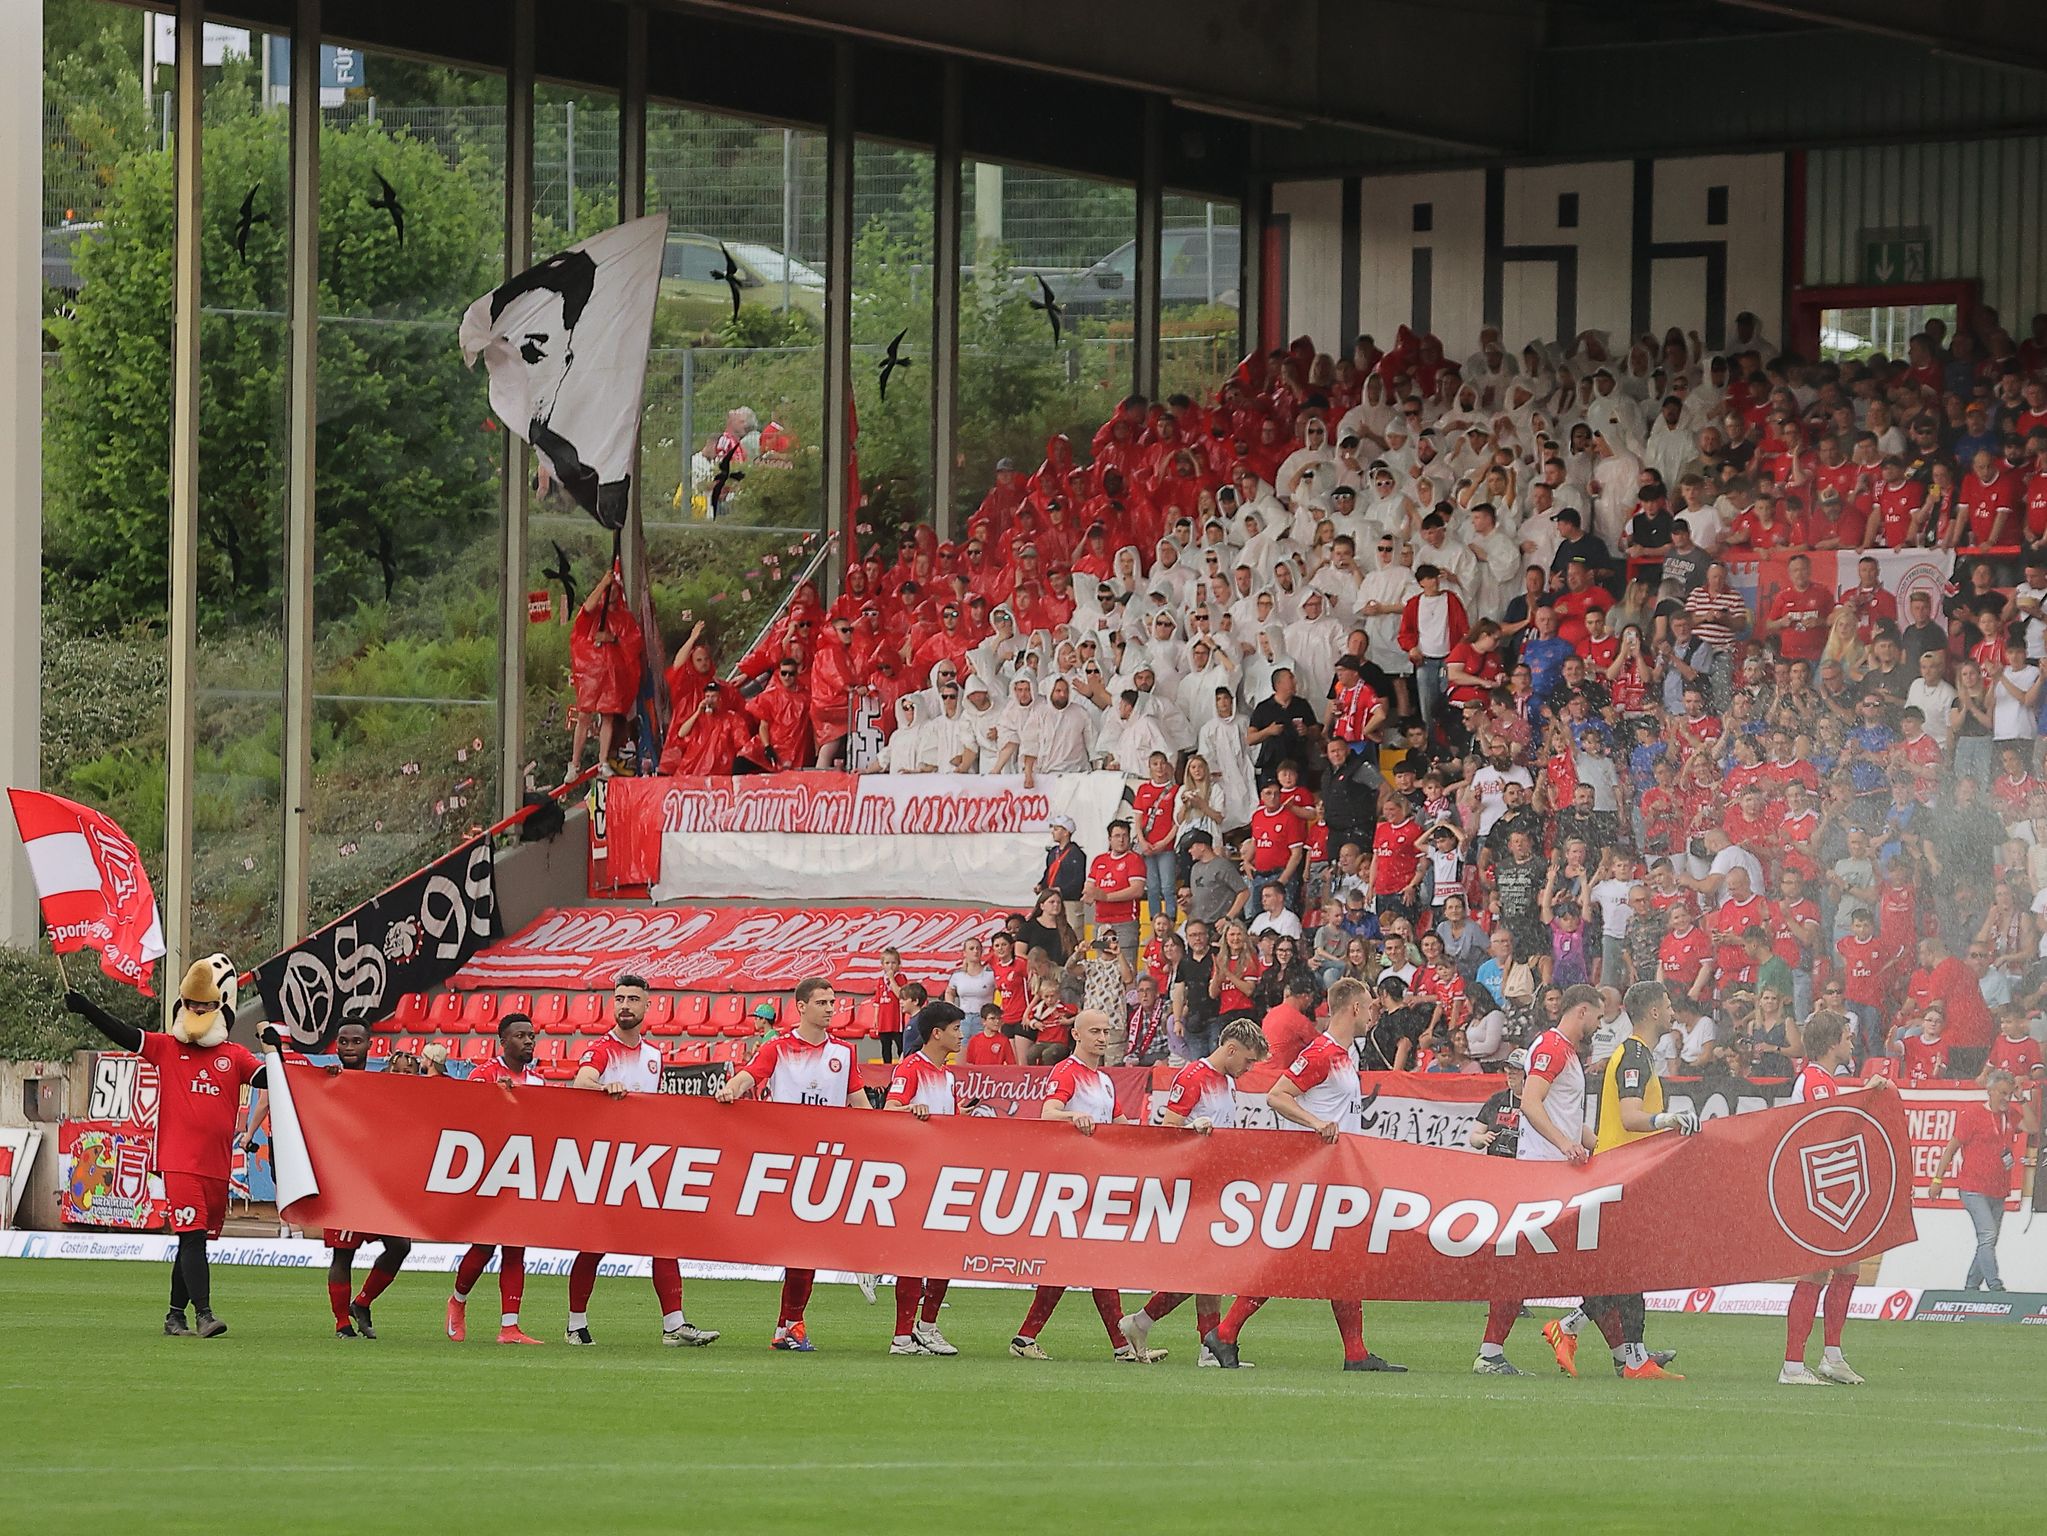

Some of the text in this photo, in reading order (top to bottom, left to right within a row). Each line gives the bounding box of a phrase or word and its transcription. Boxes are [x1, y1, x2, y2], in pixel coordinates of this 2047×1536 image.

[1272, 152, 1785, 345] 1899
[1256, 839, 1273, 848] Irle
[190, 1079, 220, 1097] Irle
[956, 1072, 1048, 1101] alltradit
[800, 1092, 828, 1106] Irle
[1378, 1107, 1477, 1147] BÄRE
[425, 1129, 1625, 1258] DANKE FÜR EUREN SUPPORT
[60, 1240, 144, 1257] Costin Baumgärtel
[236, 1247, 312, 1267] Klöckener
[962, 1255, 1047, 1277] MD PRINT
[1645, 1297, 1681, 1310] ORADI
[1932, 1301, 2013, 1314] KNETTENBRECH
